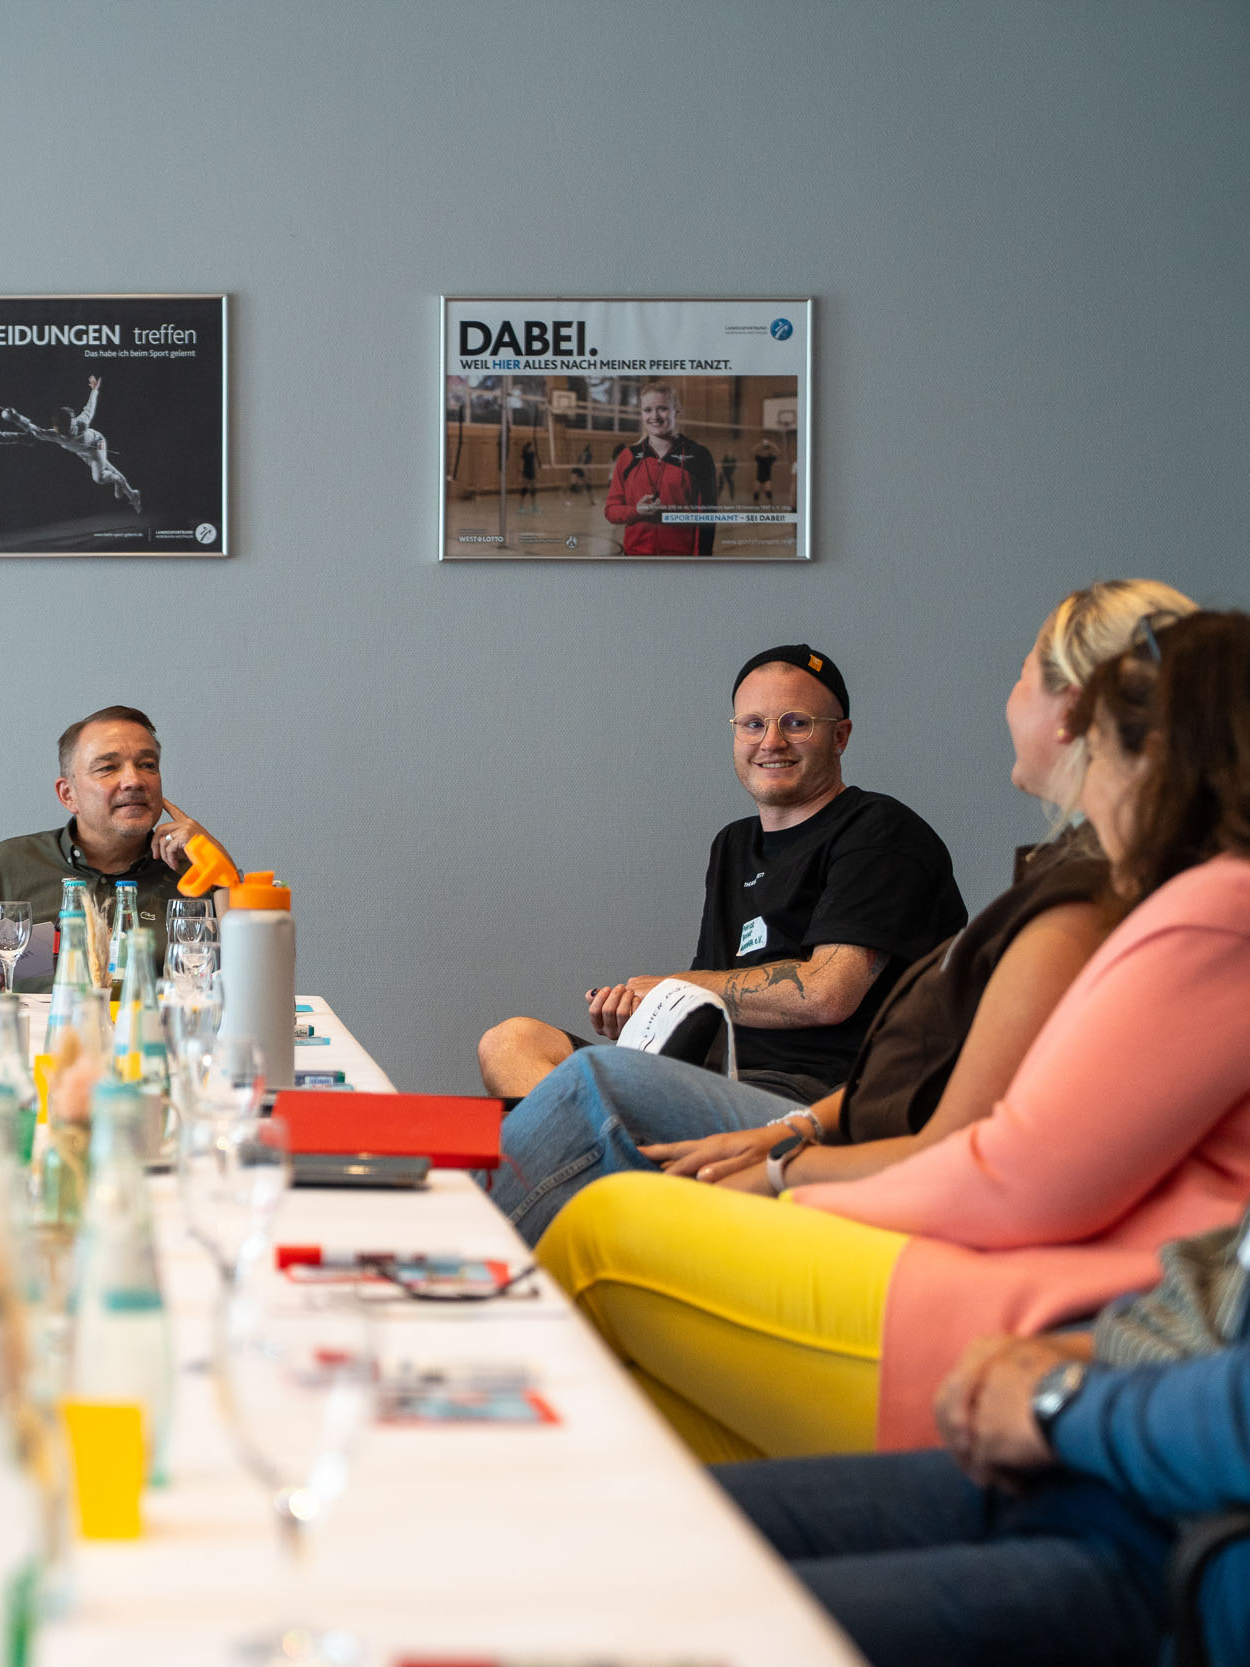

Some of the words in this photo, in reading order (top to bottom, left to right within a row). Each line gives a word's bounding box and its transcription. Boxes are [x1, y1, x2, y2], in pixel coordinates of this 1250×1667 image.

[133, 323, 197, 345] treffen
[459, 320, 598, 357] DABEI.
[84, 349, 98, 358] Das
[99, 349, 117, 358] habe
[118, 349, 129, 358] ich
[130, 349, 148, 358] beim
[149, 349, 169, 359] Sport
[170, 349, 196, 359] gelernt
[460, 359, 490, 370] WEIL
[492, 359, 520, 370] HIER
[522, 359, 558, 370] ALLES
[560, 359, 597, 370] NACH
[599, 359, 646, 370] MEINER
[650, 359, 686, 370] PFEIFE
[689, 359, 732, 370] TANZT.
